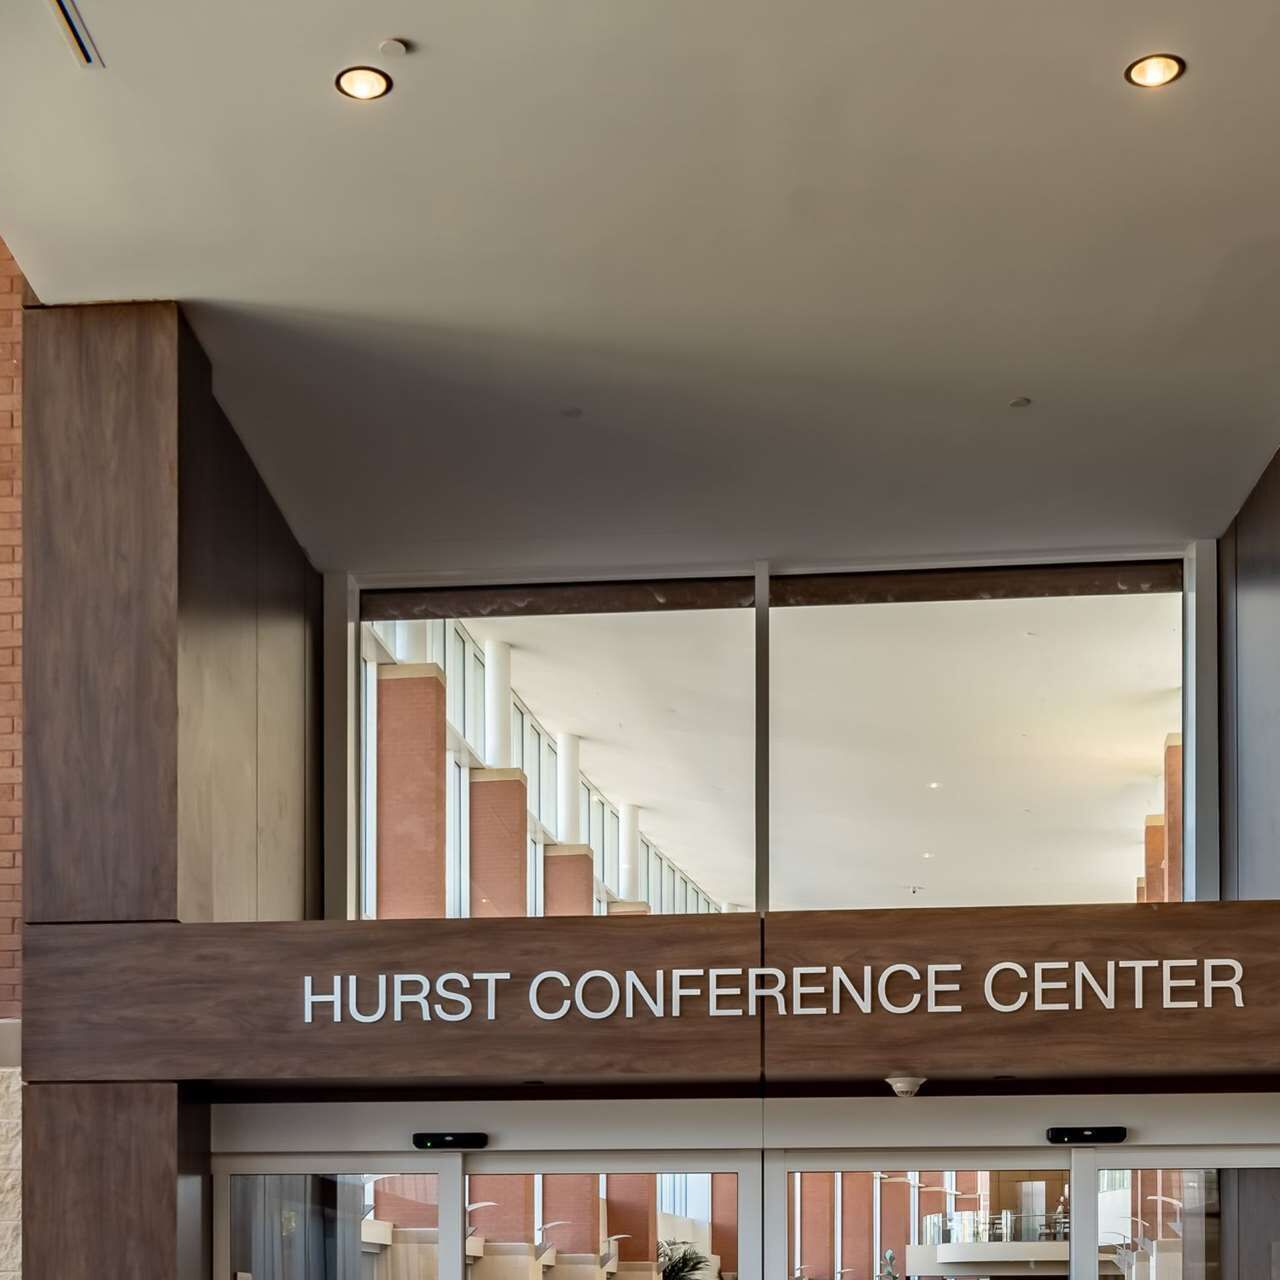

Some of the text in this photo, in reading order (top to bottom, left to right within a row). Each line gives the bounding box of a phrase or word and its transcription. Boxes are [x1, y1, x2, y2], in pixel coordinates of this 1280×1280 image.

[303, 958, 1245, 1023] HURST CONFERENCE CENTER
